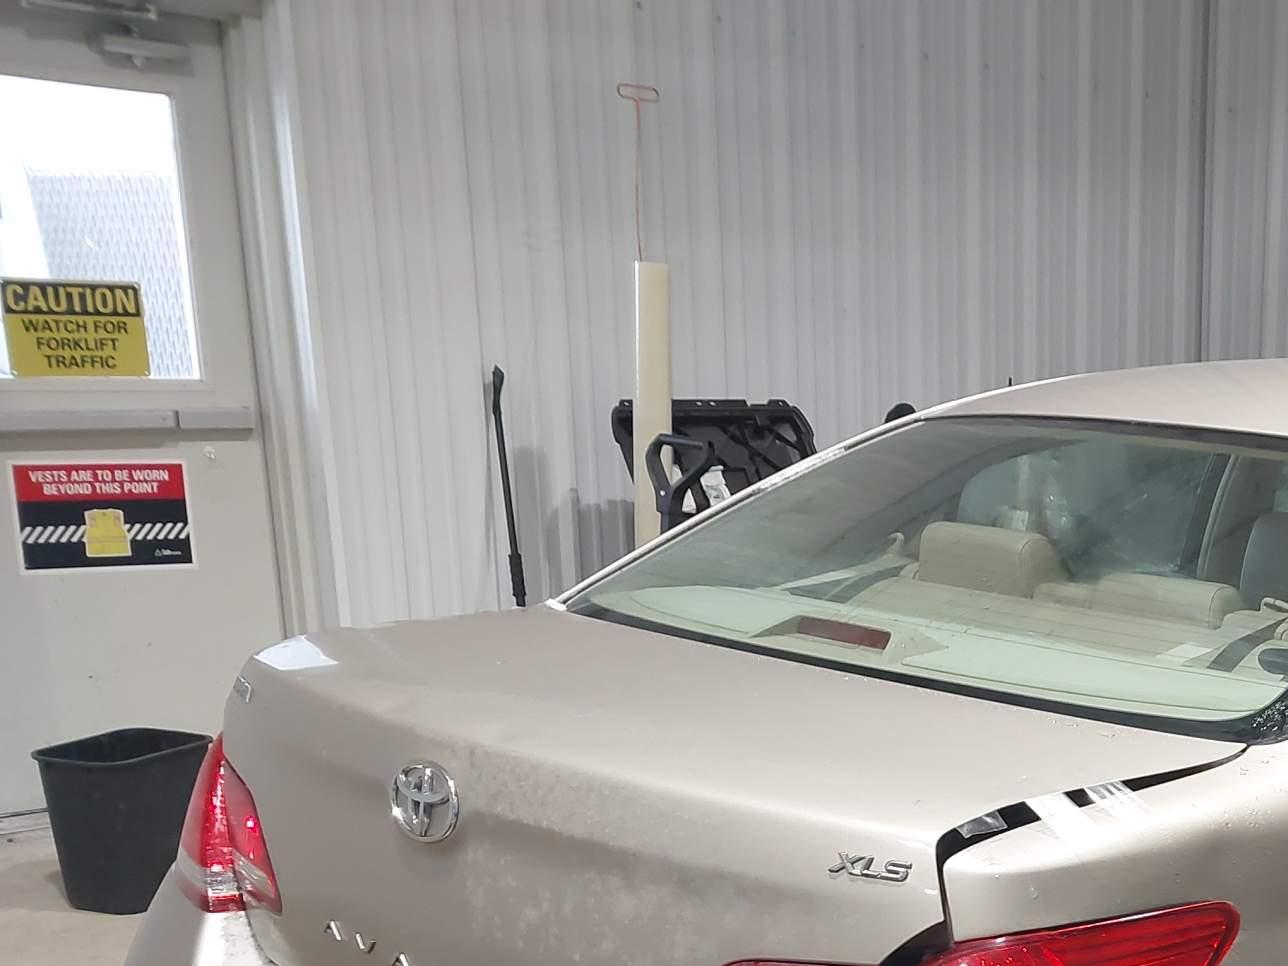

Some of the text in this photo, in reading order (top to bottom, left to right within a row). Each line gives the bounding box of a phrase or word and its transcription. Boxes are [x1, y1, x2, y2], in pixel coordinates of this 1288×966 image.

[5, 284, 137, 314] CAUTION
[20, 318, 128, 334] WATCH FOR
[36, 337, 118, 351] FORKLIFT
[43, 354, 117, 369] TRAFFIC
[29, 469, 169, 483] VESTS ARE TO BE WORN
[43, 482, 159, 495] BEYOND THIS POINT
[828, 852, 912, 882] XLS
